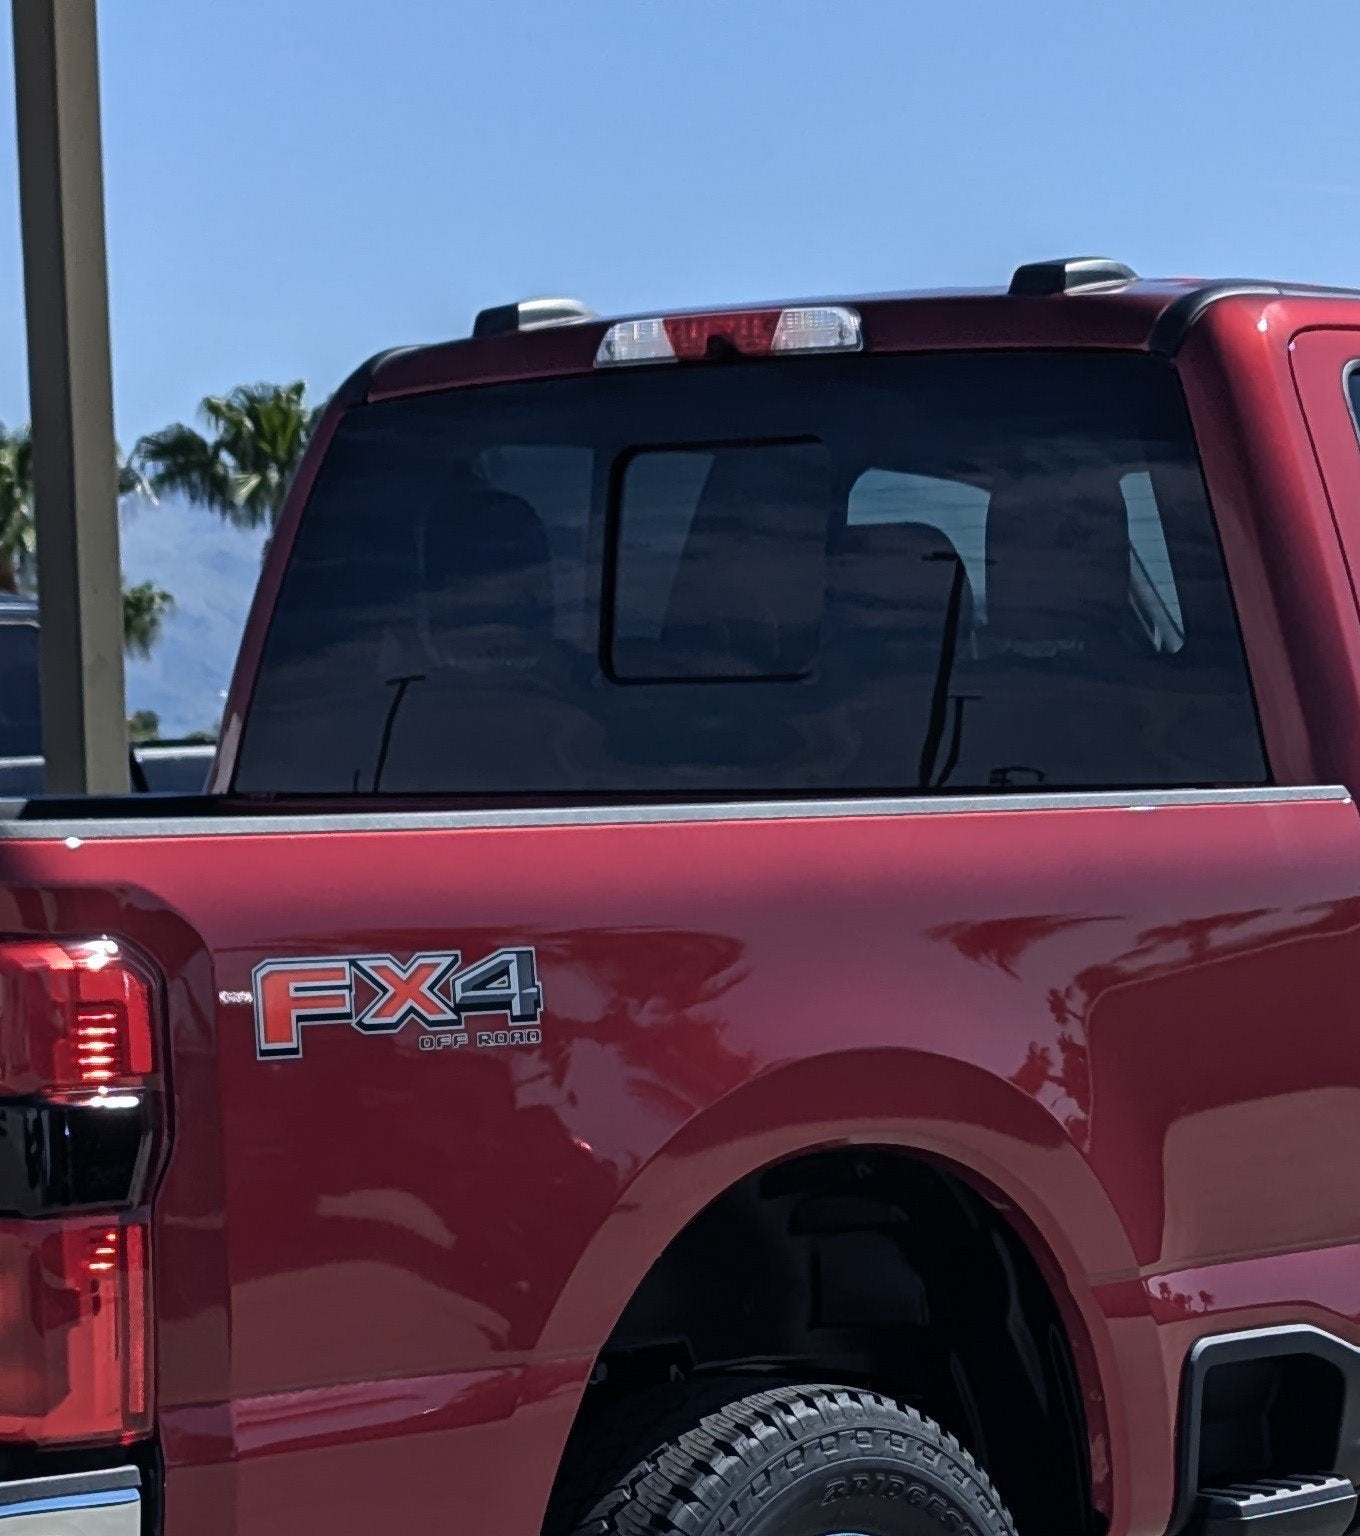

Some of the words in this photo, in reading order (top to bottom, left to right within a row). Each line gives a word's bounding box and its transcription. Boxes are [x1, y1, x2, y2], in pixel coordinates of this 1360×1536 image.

[252, 946, 543, 1060] FX4
[419, 1033, 469, 1051] OFF
[476, 1029, 541, 1047] ROAD
